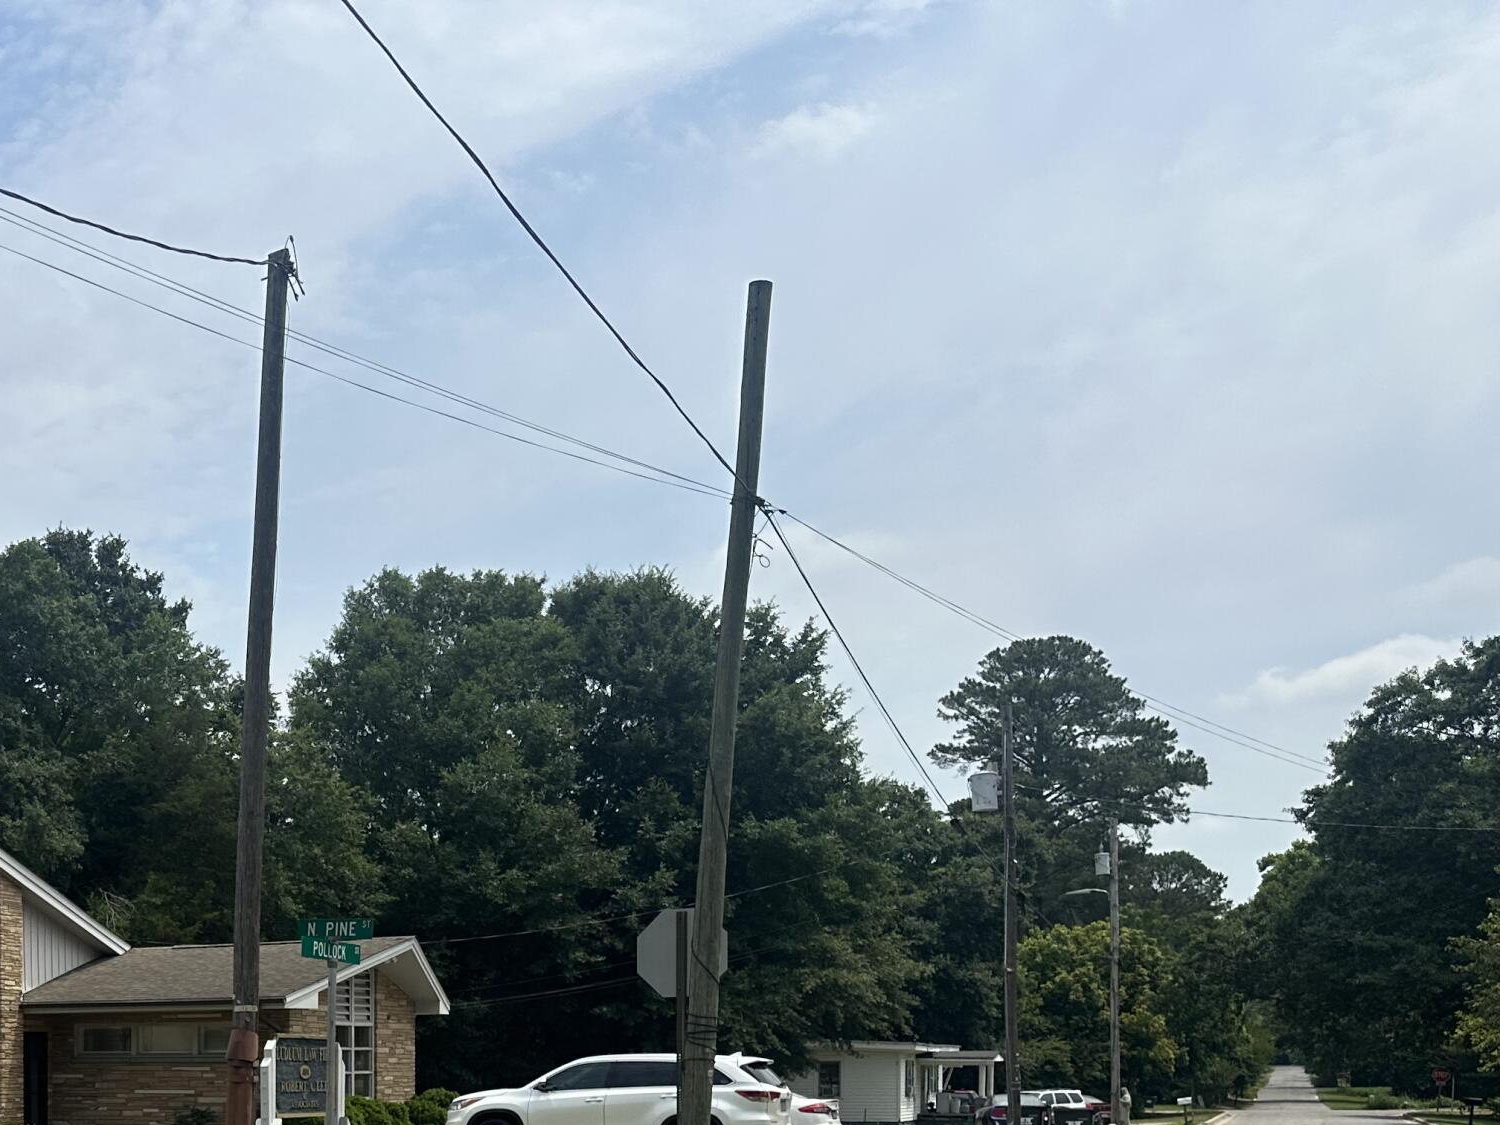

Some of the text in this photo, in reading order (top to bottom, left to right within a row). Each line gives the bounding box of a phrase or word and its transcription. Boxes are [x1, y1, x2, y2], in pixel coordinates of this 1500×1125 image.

[325, 921, 357, 937] PINE
[362, 919, 372, 928] ST
[312, 940, 347, 960] POLLOCK
[304, 1047, 317, 1061] LAW
